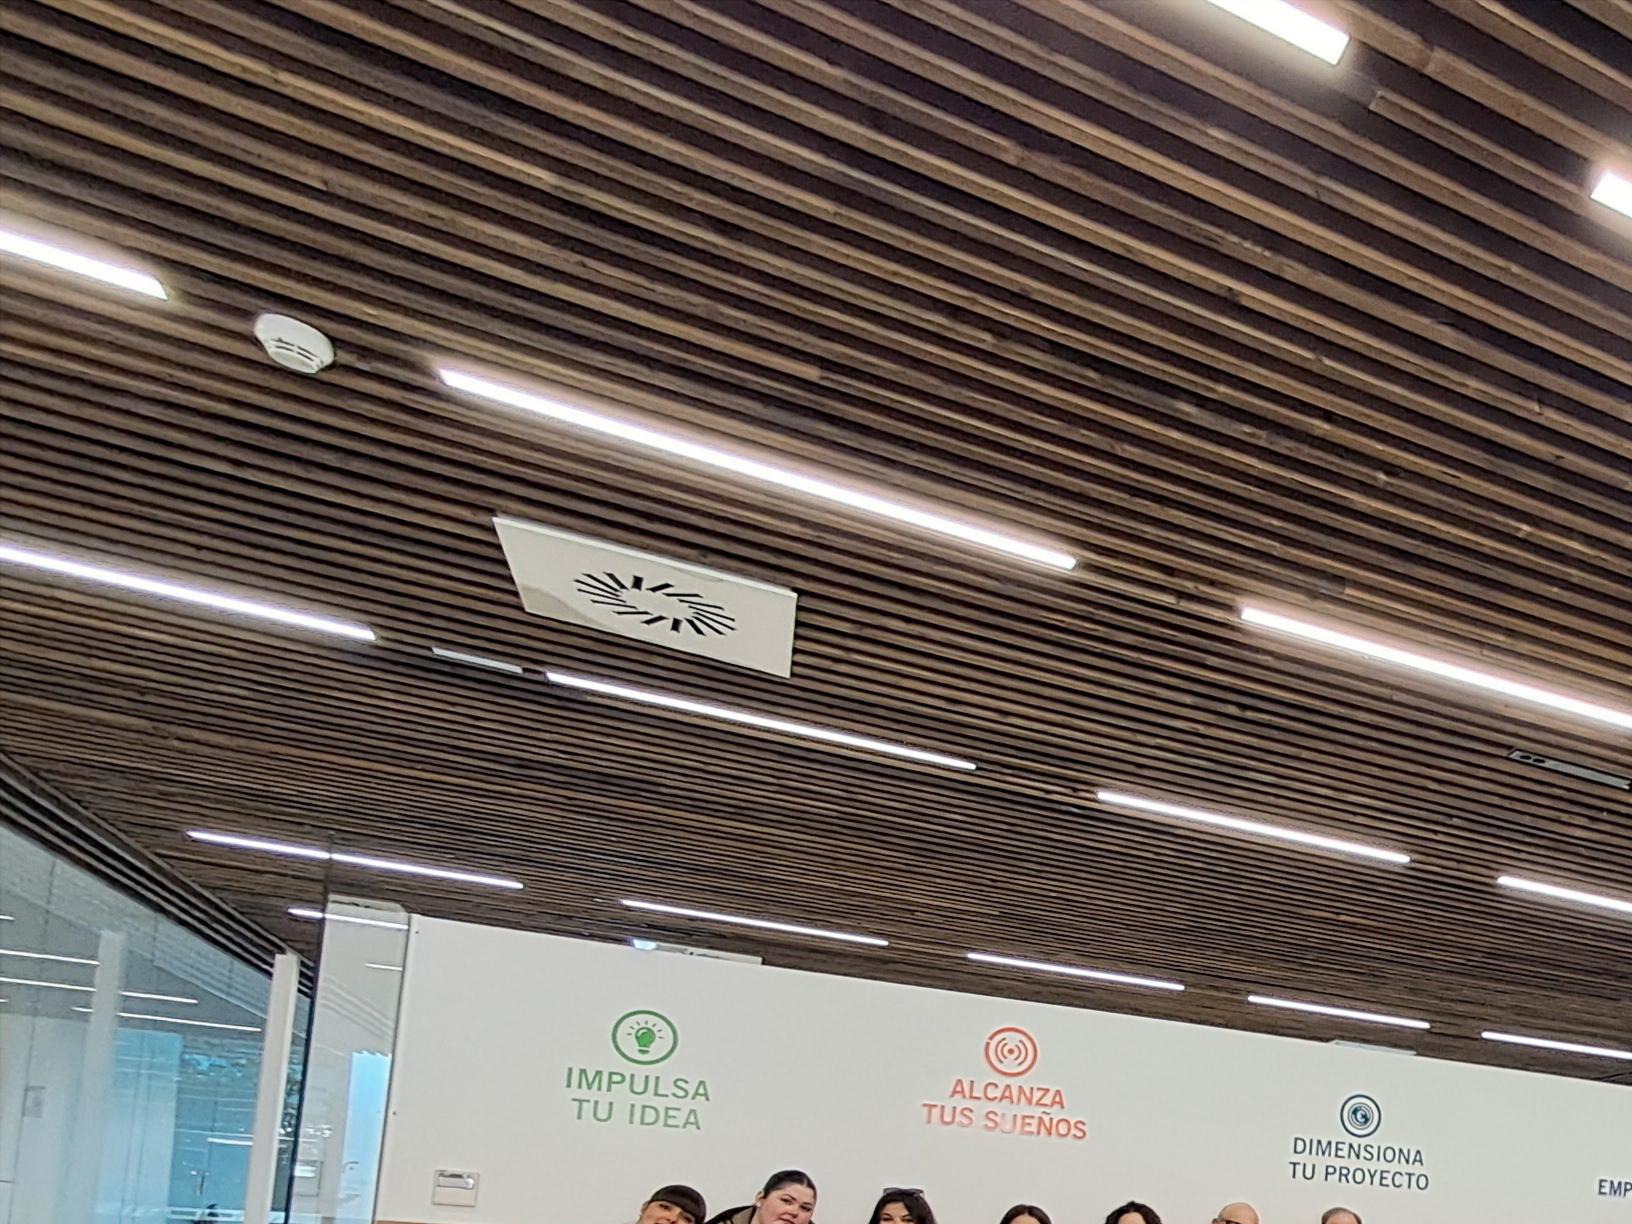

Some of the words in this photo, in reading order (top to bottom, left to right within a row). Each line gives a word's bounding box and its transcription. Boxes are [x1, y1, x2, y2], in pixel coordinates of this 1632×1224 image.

[565, 1067, 710, 1101] IMPULSA
[949, 1078, 1065, 1109] ALCANZA
[571, 1098, 614, 1122] TU
[628, 1103, 701, 1130] IDEA
[922, 1102, 974, 1128] TUS
[984, 1109, 1087, 1140] SUEÑOS
[1293, 1137, 1424, 1166] DIMENSIONA
[1289, 1162, 1316, 1180] TU
[1324, 1165, 1429, 1190] PROYECTO
